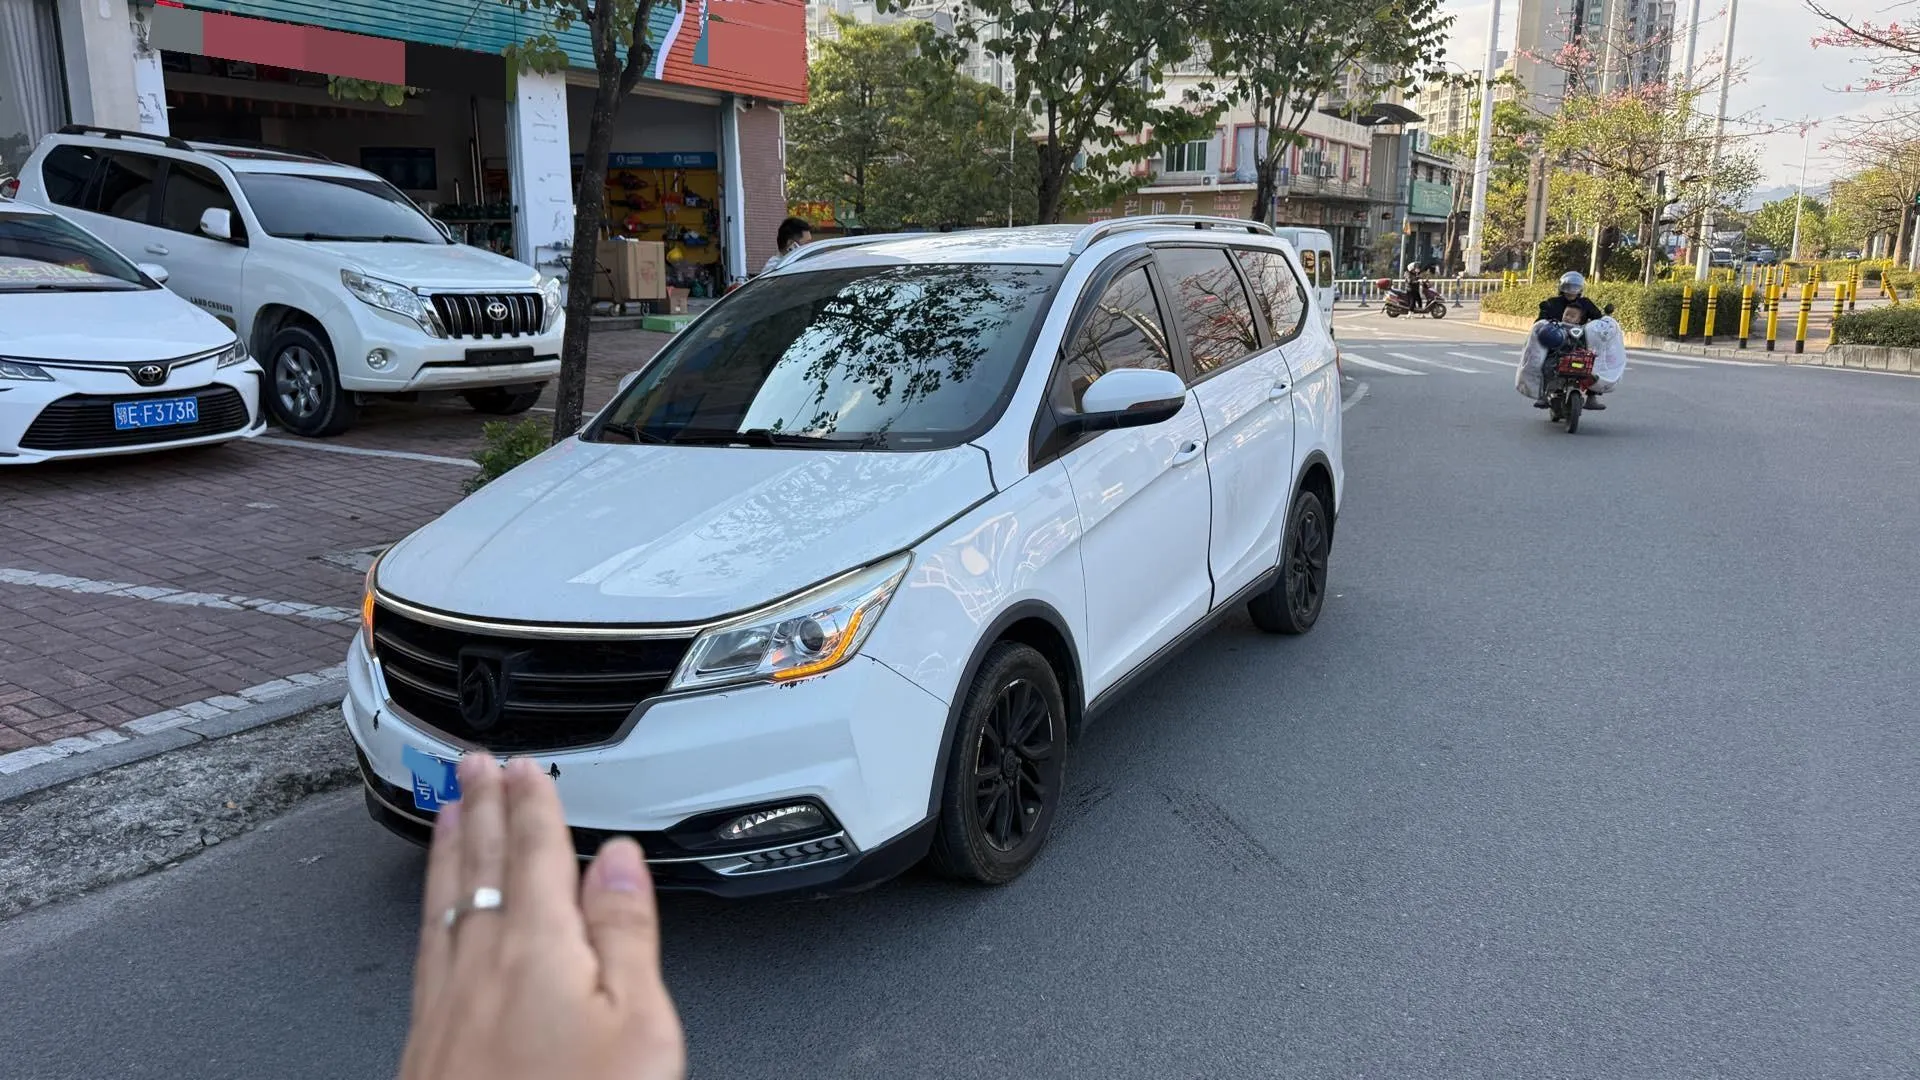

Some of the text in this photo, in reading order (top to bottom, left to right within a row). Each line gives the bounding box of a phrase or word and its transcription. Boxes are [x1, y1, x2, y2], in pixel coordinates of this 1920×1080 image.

[1124, 199, 1194, 216] 老地方
[190, 296, 234, 313] LAND CRUISER
